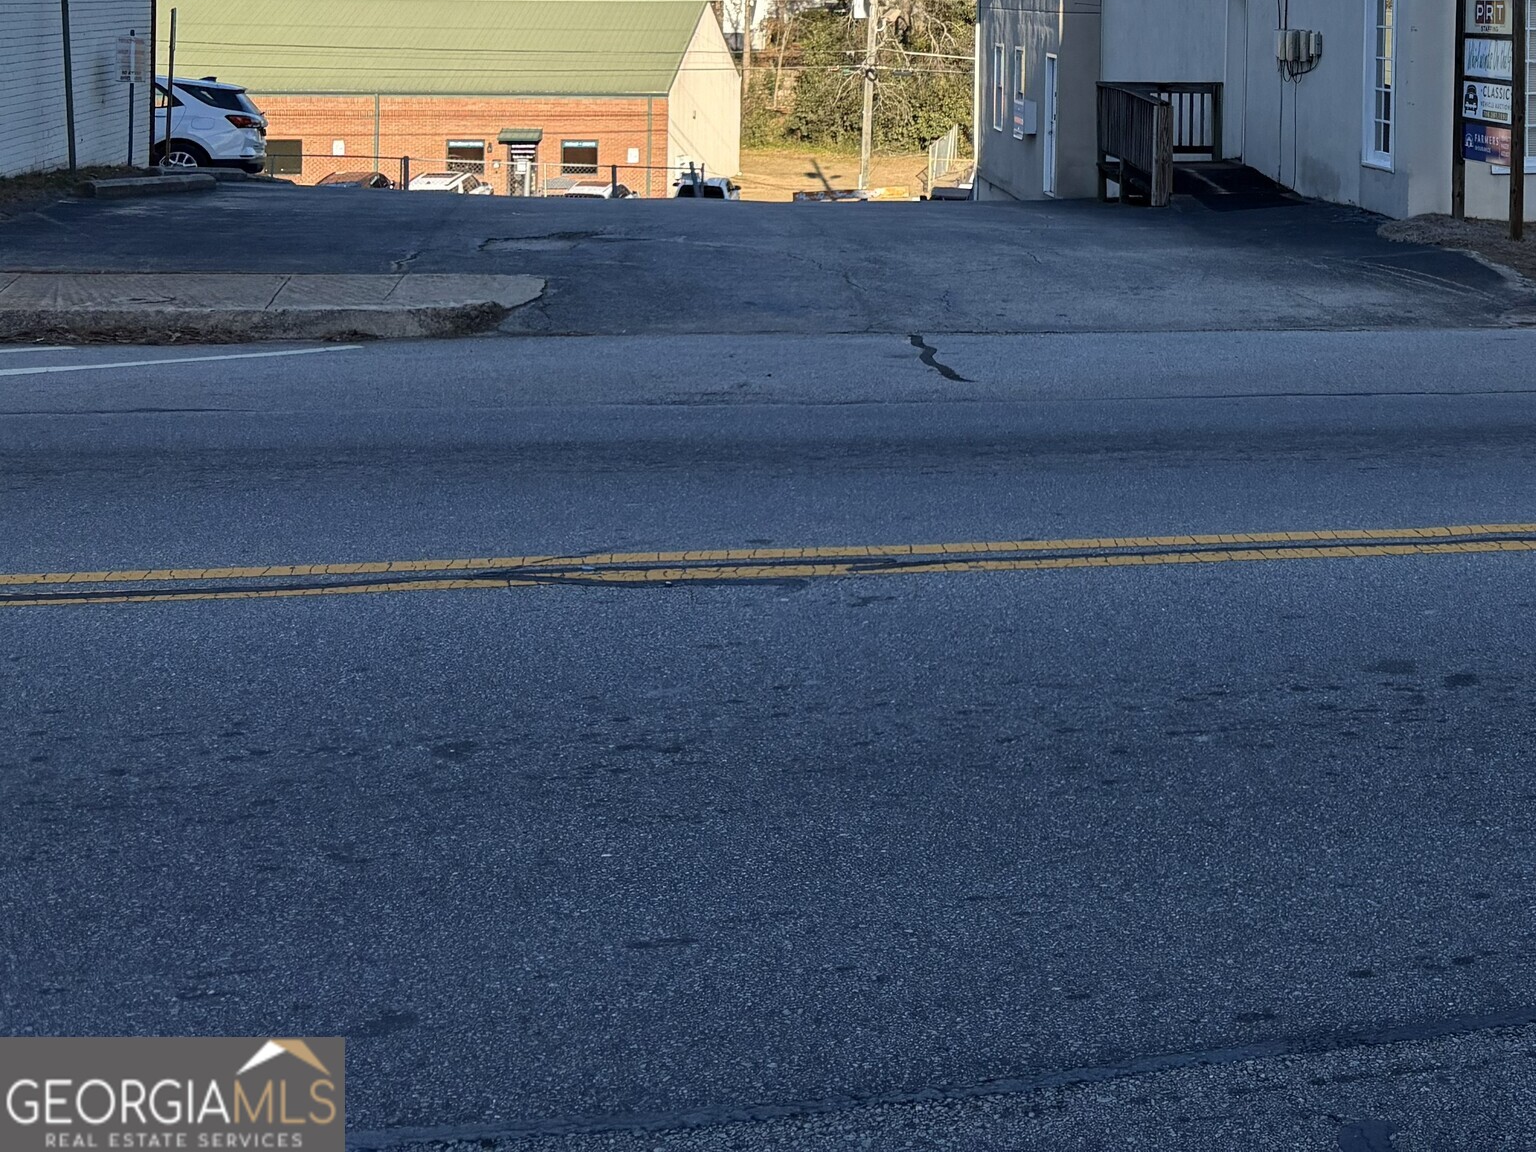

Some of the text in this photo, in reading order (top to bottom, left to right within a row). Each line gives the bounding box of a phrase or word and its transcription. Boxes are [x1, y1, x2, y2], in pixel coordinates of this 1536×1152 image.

[1476, 4, 1504, 21] PRT
[1483, 85, 1510, 100] CLASSIC
[1474, 133, 1499, 146] FARMERS
